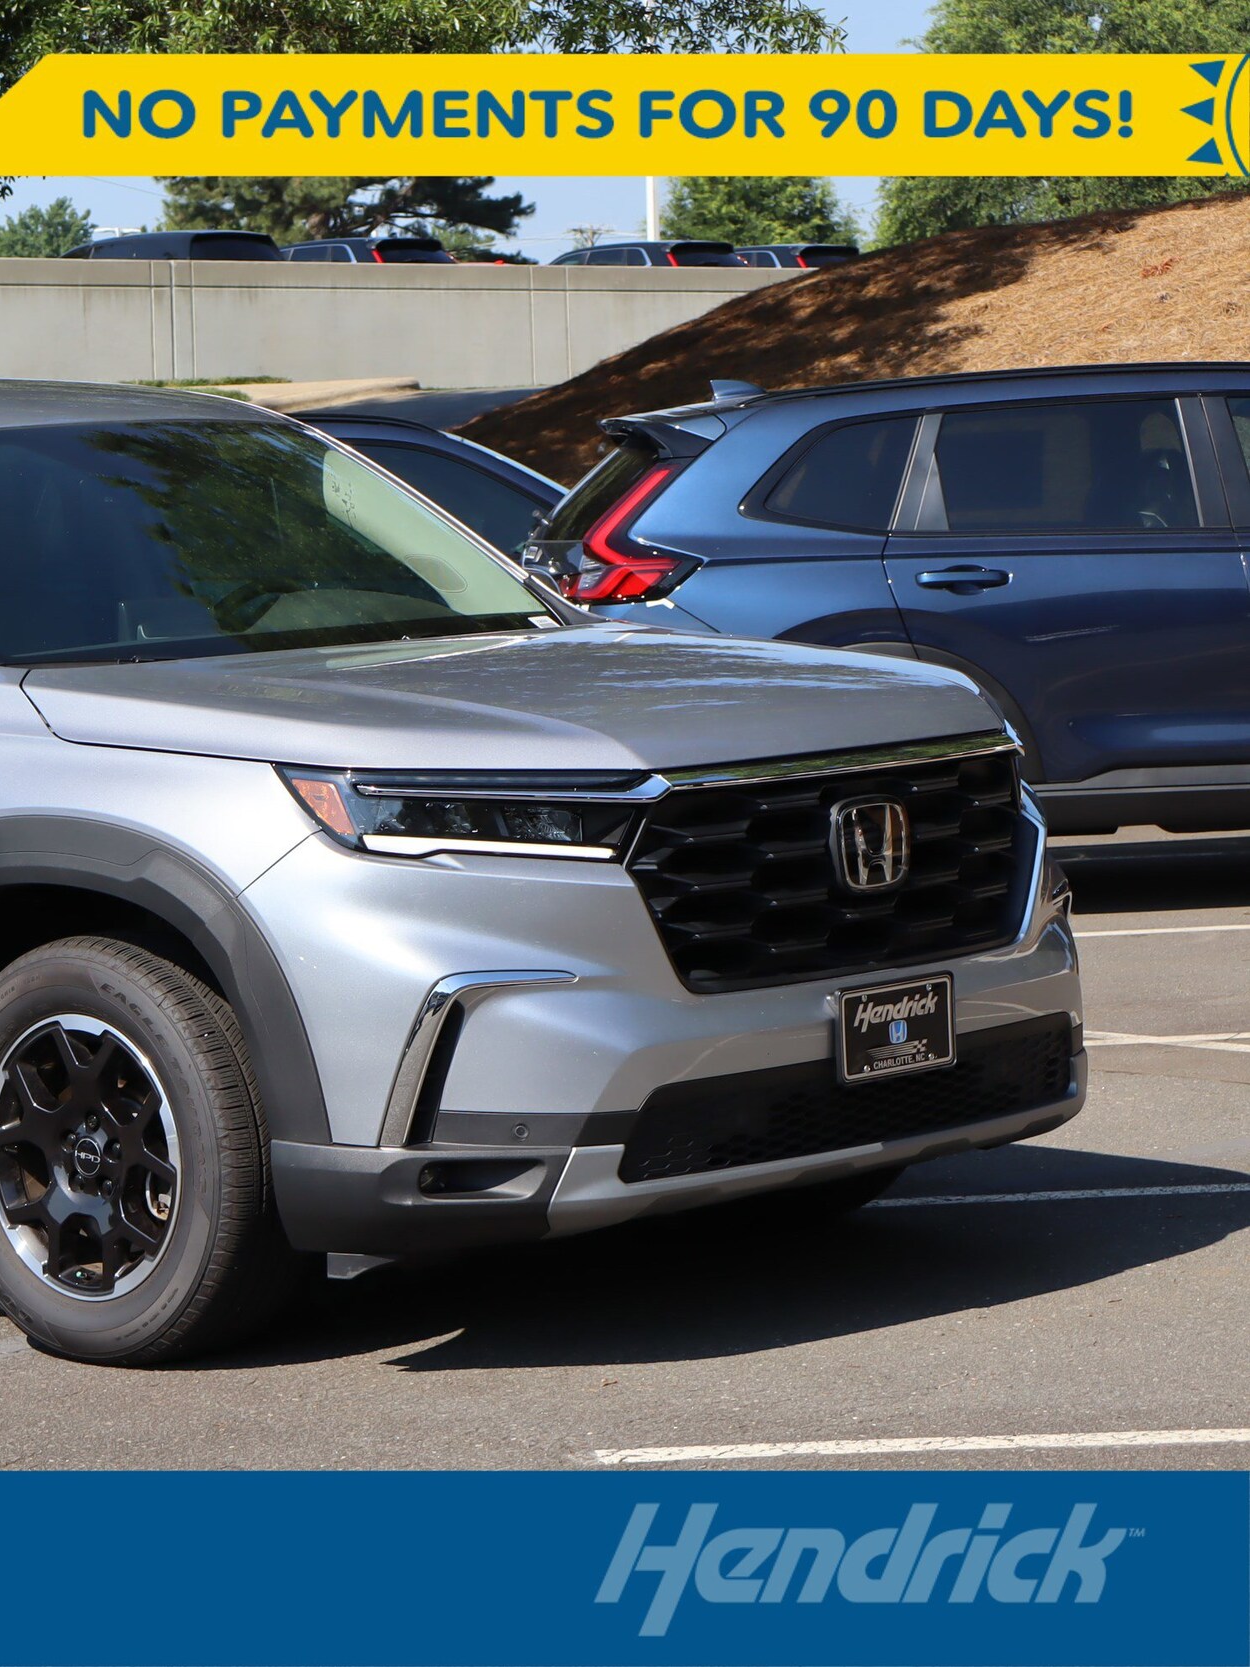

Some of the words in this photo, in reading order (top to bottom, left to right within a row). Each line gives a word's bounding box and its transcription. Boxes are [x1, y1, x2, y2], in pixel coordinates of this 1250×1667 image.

[100, 982, 169, 1048] EAGLE
[853, 991, 939, 1033] Hendrick
[915, 1052, 926, 1062] NC
